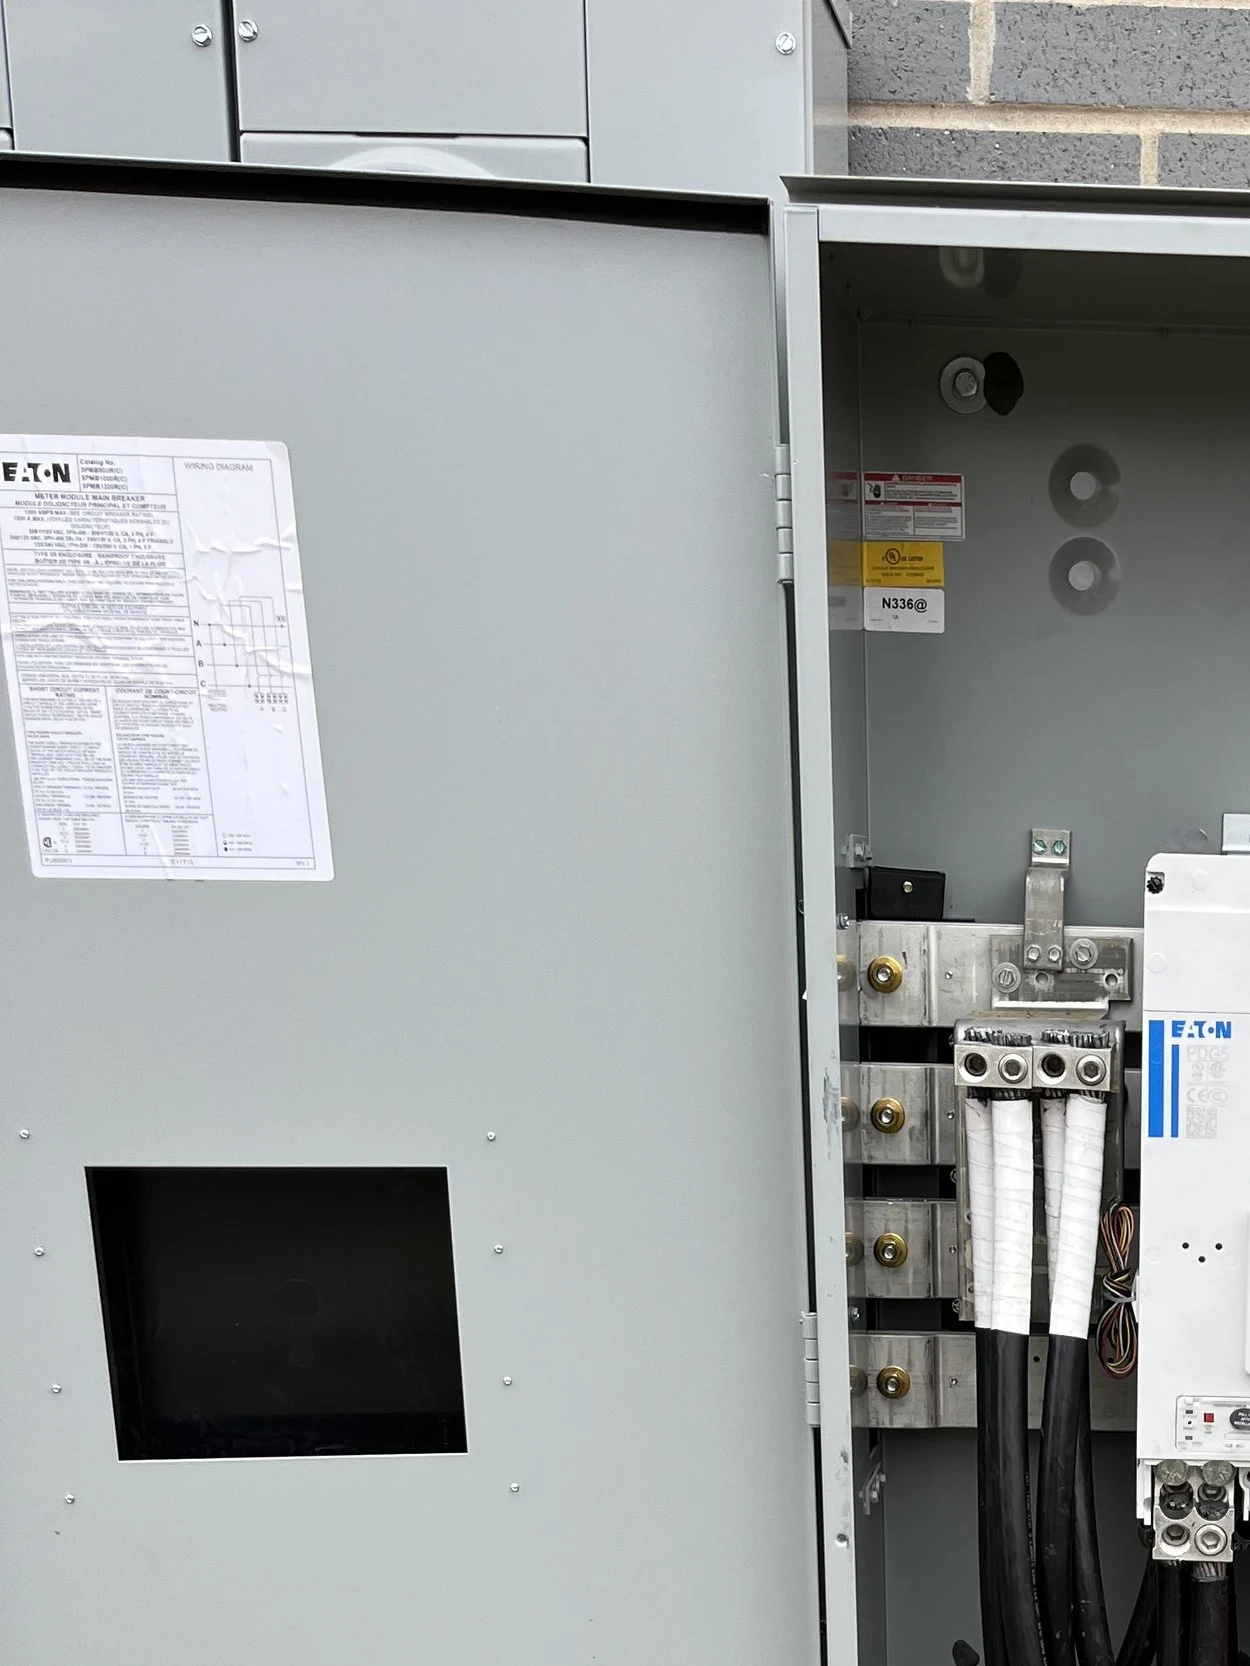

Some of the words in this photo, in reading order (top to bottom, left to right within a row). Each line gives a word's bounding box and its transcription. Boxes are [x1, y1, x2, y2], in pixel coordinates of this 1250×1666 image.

[80, 458, 104, 467] Catalog
[184, 461, 215, 471] WIRING
[216, 463, 254, 472] DIAGRAM
[2, 461, 71, 484] EATON
[34, 492, 59, 500] METER
[60, 493, 90, 501] MODULE
[882, 597, 928, 614] N336@
[200, 680, 207, 688] C
[1172, 1020, 1231, 1039] EATON
[1187, 1046, 1229, 1062] PDG5
